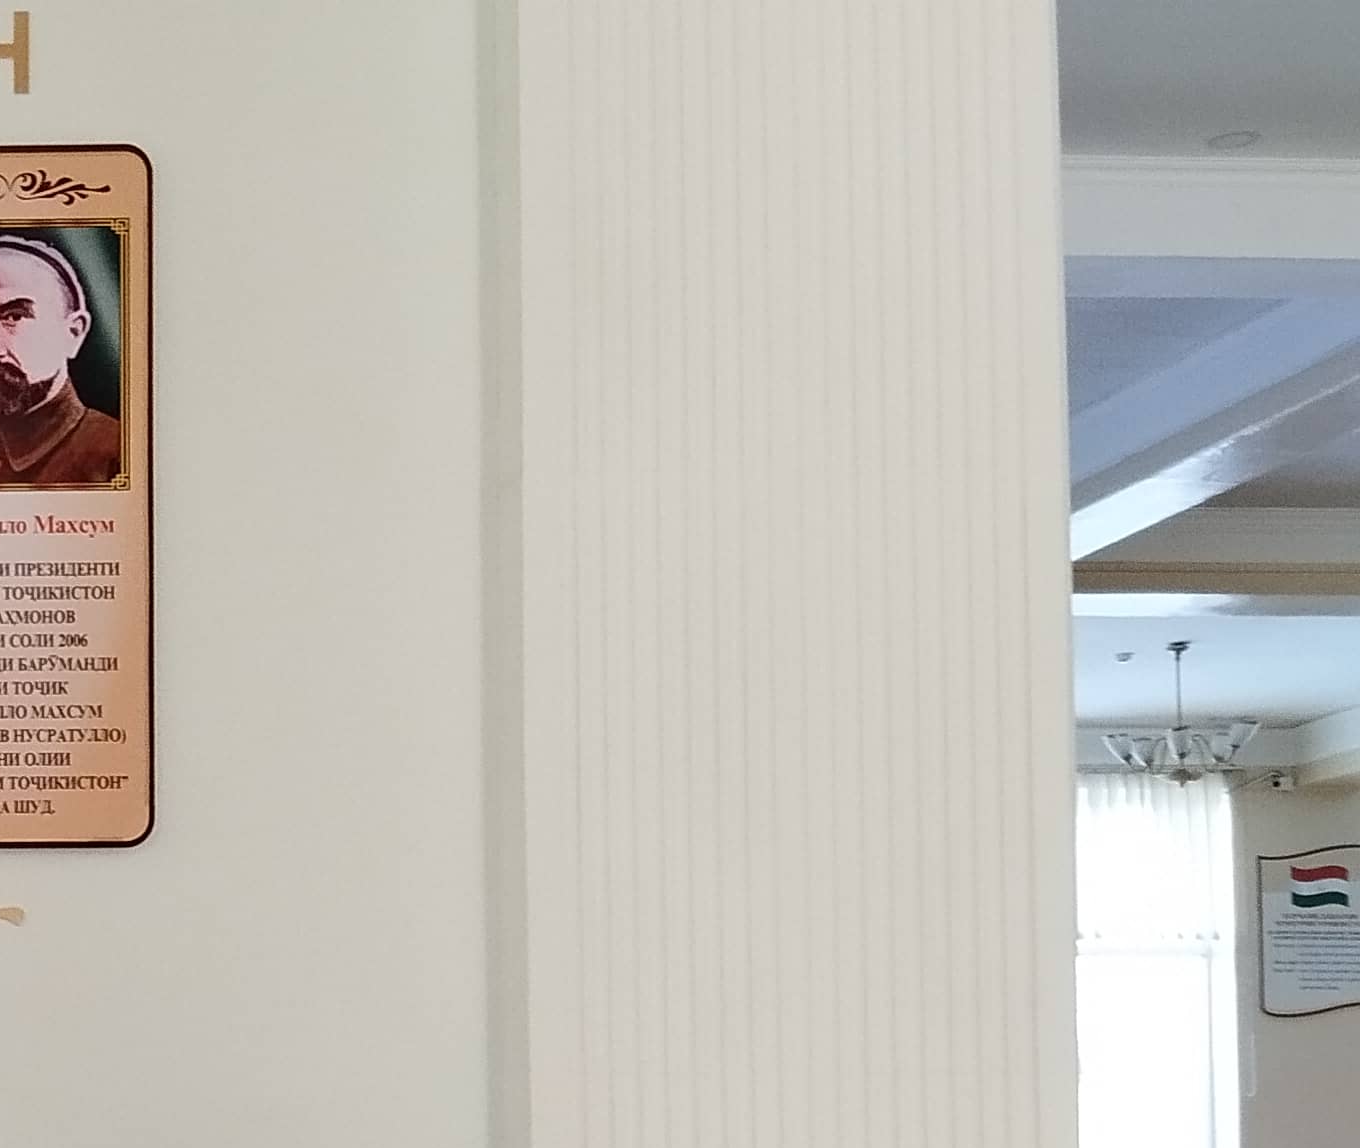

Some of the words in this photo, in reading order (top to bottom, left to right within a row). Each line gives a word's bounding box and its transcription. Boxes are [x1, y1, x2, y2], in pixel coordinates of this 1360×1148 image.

[33, 515, 115, 538] Махсум
[13, 562, 120, 578] ПРЕЗИДЕНТИ
[9, 634, 54, 648] СОЛИ
[58, 634, 88, 648] 2006
[31, 705, 103, 719] МАХСУМ
[13, 728, 128, 744] НУСРАТУЛЛО)
[24, 752, 71, 767] ОЛИИ
